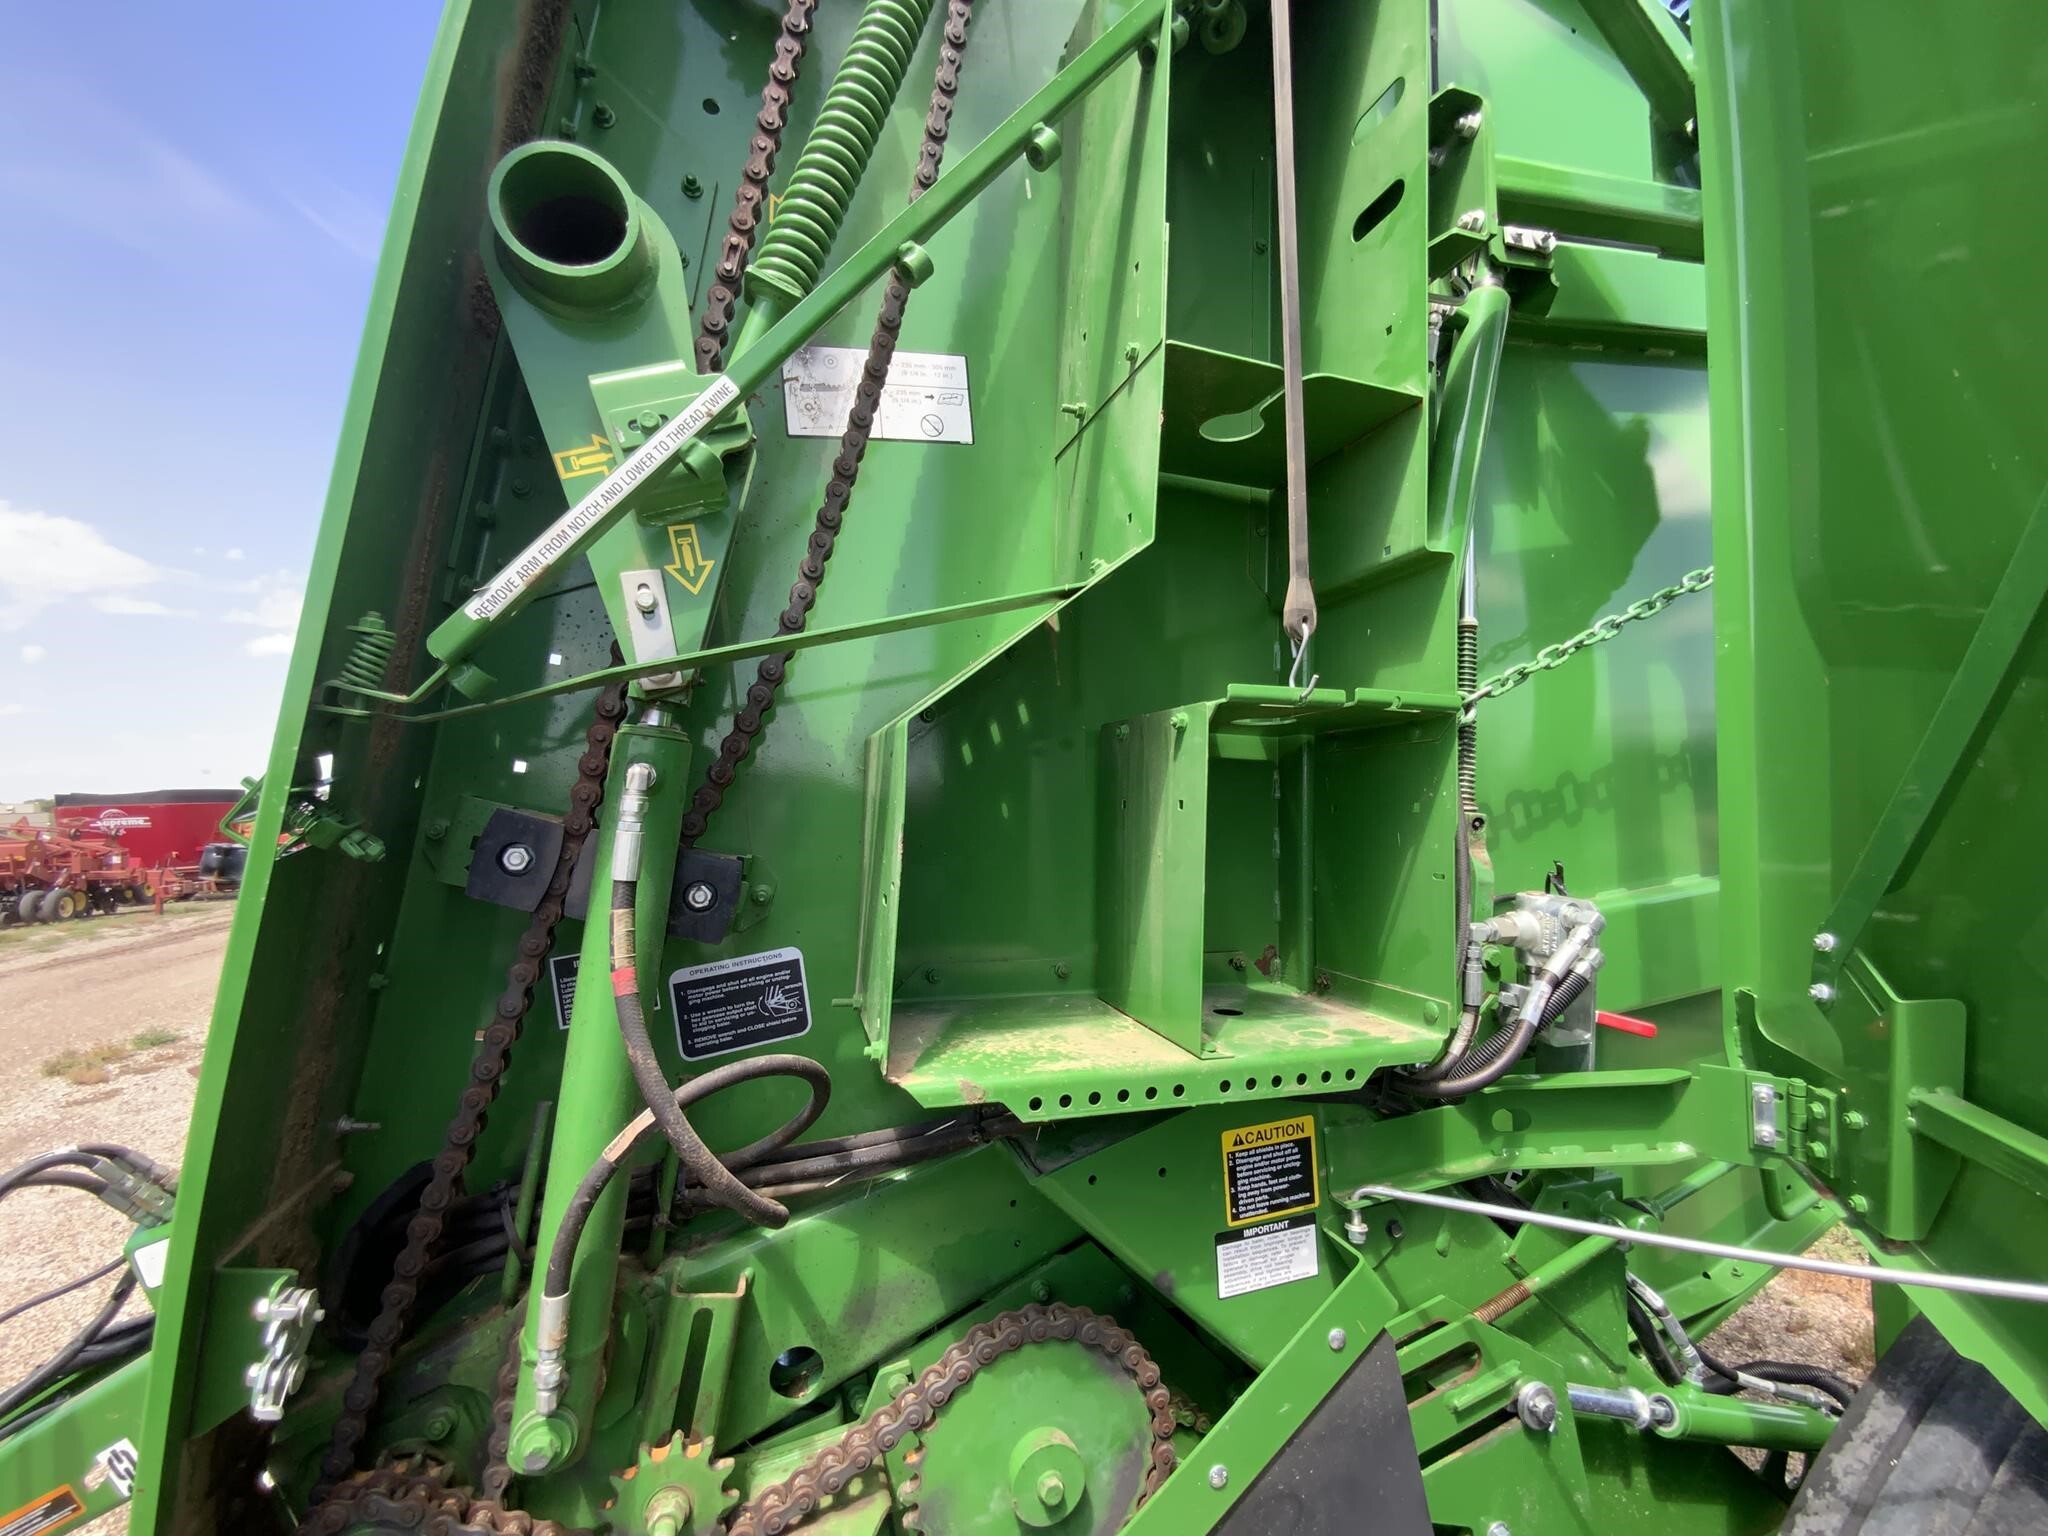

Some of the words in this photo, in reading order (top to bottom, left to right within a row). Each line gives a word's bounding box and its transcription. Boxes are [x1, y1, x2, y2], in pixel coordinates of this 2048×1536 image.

[472, 576, 521, 620] REMOVE
[514, 555, 544, 582] ARM
[538, 529, 572, 560] FROM
[566, 499, 605, 534] NOTCH
[599, 481, 624, 504] AND
[619, 451, 657, 486] LOWER
[652, 439, 670, 456] TO
[666, 407, 706, 444] THREAD
[701, 382, 734, 413] TWINE
[689, 962, 728, 976] OPERATING
[731, 951, 782, 968] INSTRUCTIONS
[686, 984, 714, 996] Disengage
[756, 972, 773, 981] engine
[704, 988, 721, 997] power
[722, 984, 739, 992] before
[740, 979, 763, 989] servicing
[706, 1006, 726, 1015] wrench
[694, 1033, 716, 1043] REMOVE
[717, 1029, 736, 1038] wrench
[747, 1023, 764, 1031] CLOSE
[1244, 1121, 1304, 1144] CAUTION
[1235, 1150, 1248, 1158] Keep
[1255, 1145, 1273, 1153] shields
[1235, 1154, 1261, 1165] Disengage
[1236, 1163, 1253, 1172] engine
[1253, 1165, 1276, 1175] servicing
[1243, 1220, 1289, 1237] IMPORTANT
